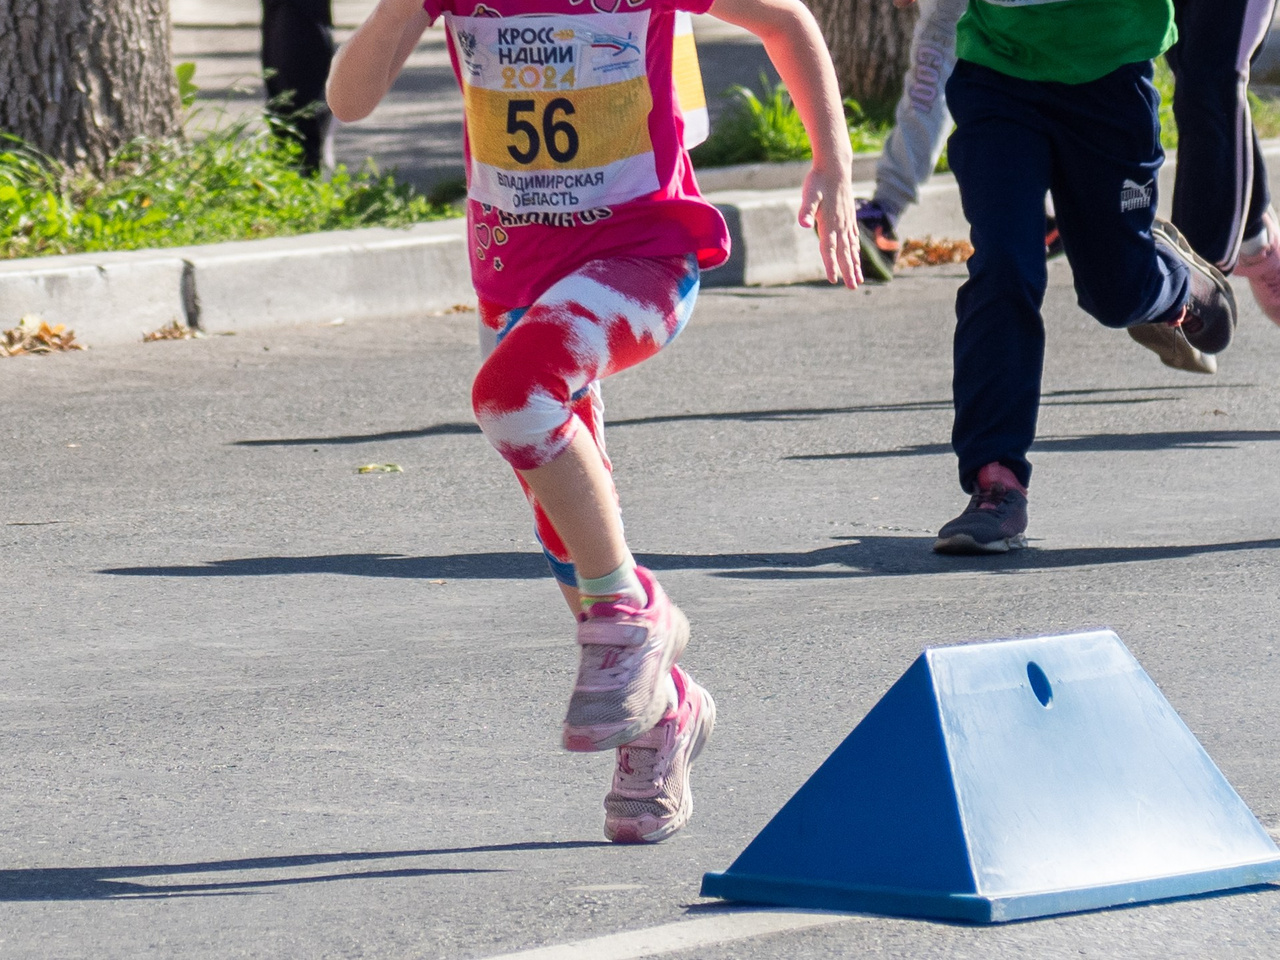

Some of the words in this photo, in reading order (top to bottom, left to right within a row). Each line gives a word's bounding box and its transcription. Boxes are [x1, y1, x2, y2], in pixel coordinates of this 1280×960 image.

[497, 27, 554, 45] КРОСС
[499, 45, 574, 66] НАЦИИ
[501, 65, 576, 89] 2024
[506, 98, 579, 165] 56
[497, 171, 604, 192] ВЛАДИМИРСКАЯ
[512, 191, 580, 208] ОБЛАСТЬ
